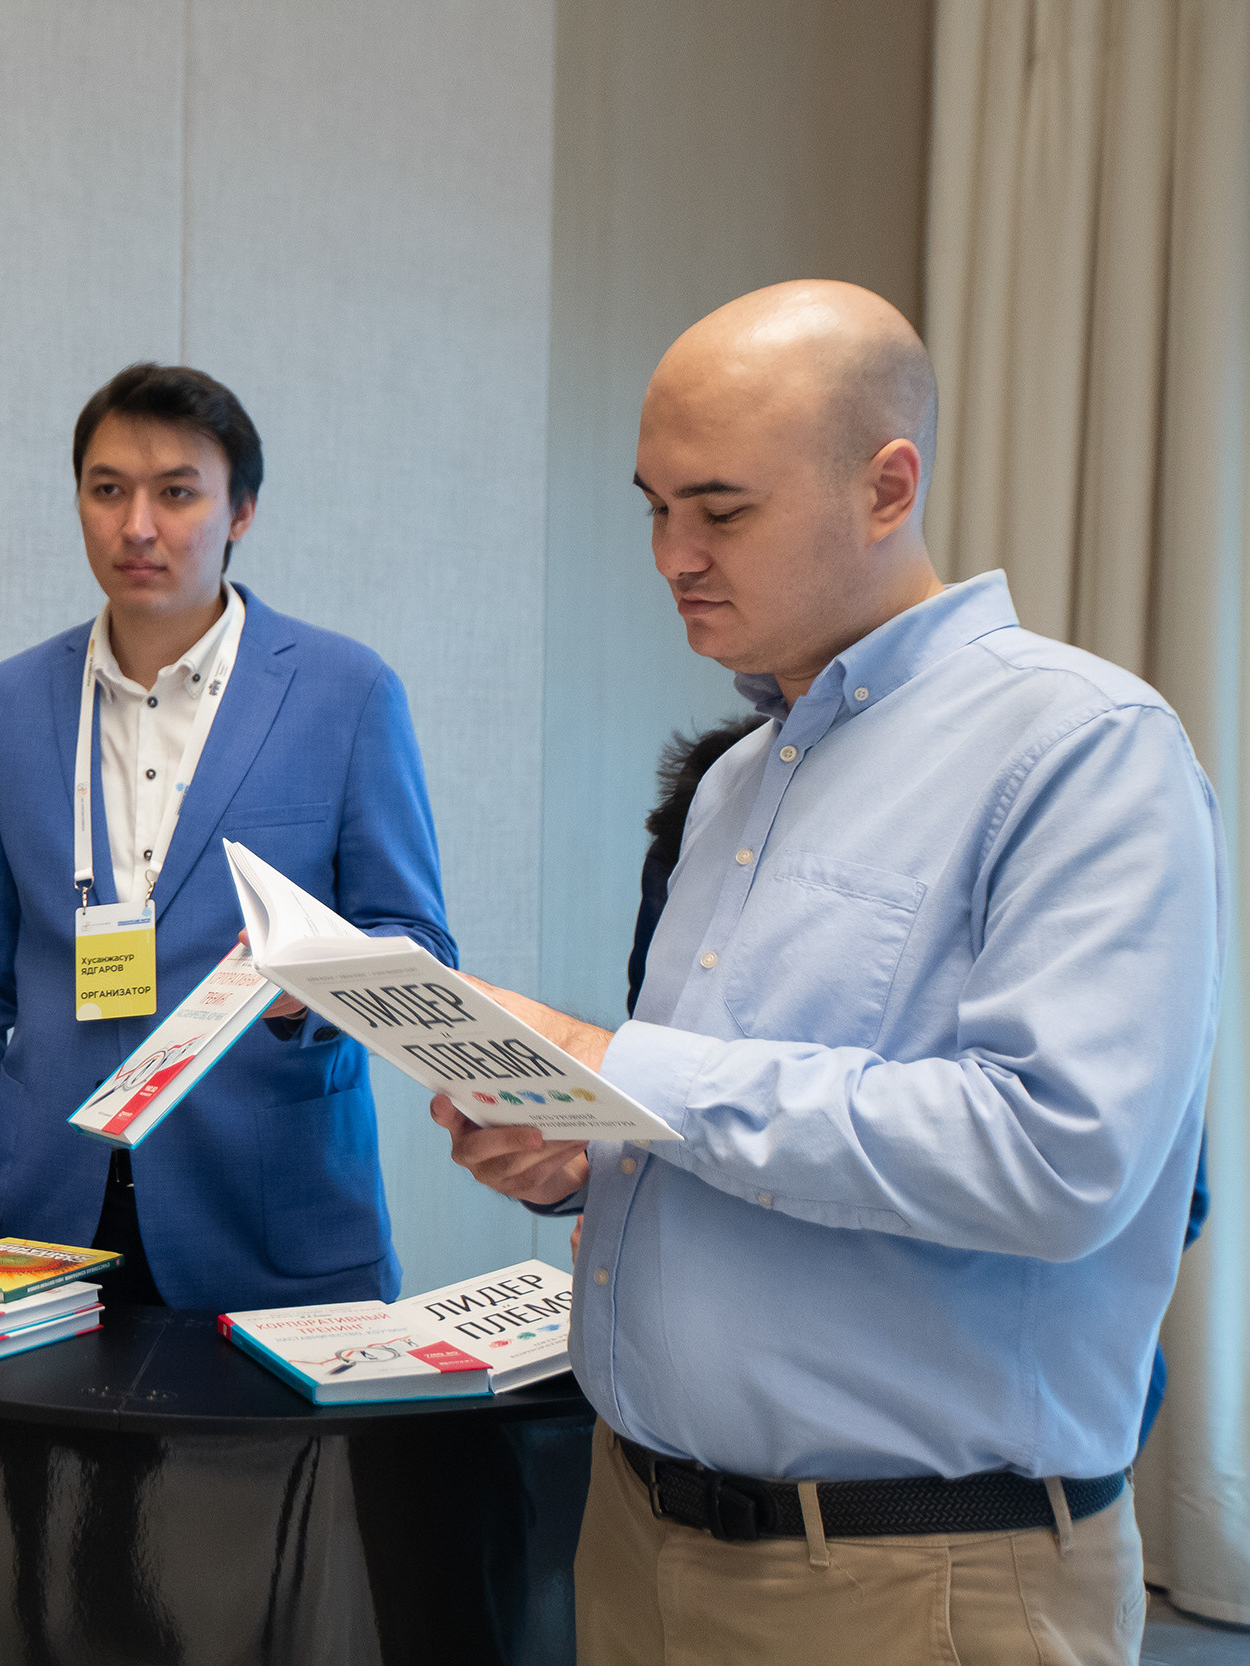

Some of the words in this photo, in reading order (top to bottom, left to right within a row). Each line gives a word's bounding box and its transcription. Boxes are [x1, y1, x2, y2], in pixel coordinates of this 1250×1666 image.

[81, 964, 124, 976] ЯДГАРОВ
[80, 985, 152, 1000] ОРГАНИЗАТОР
[329, 982, 478, 1030] ЛИДЕР
[401, 1038, 567, 1081] ПЛЕМЯ
[423, 1273, 544, 1322] ЛИДЕР
[255, 1311, 392, 1331] КОРПОРАТИВНЫЙ
